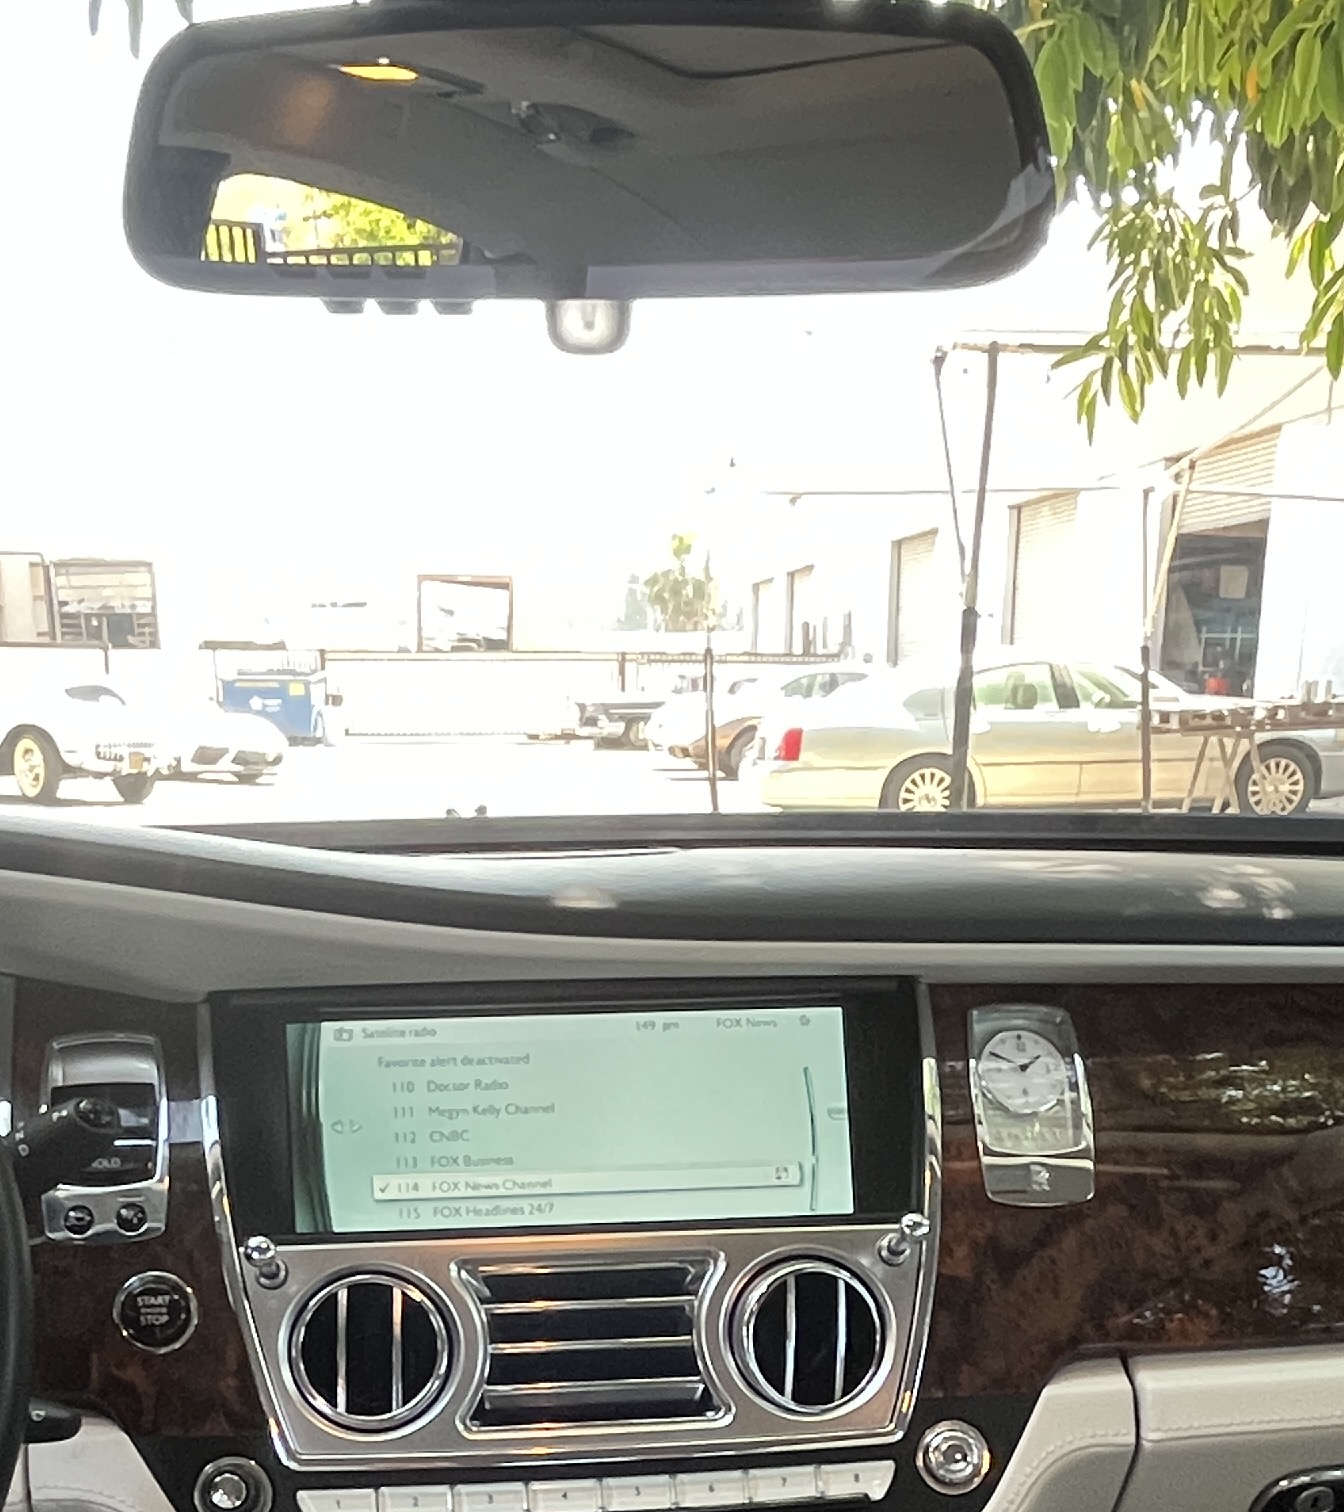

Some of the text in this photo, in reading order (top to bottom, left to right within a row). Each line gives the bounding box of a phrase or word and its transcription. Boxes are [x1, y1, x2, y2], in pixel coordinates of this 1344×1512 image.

[716, 1017, 778, 1029] FOX News
[429, 1054, 457, 1068] alert
[460, 1053, 531, 1067] deactivated
[391, 1078, 509, 1094] 110 Doctor Radio
[393, 1106, 414, 1119] 111
[472, 1103, 502, 1118] Kelly
[504, 1102, 556, 1116] Channel
[394, 1129, 471, 1144] 112 CNBC
[430, 1155, 460, 1168] FOX
[397, 1178, 553, 1193] 114 FOX News Channel
[398, 1202, 555, 1220] 115 FOX Headlines 24/7
[137, 1294, 171, 1307] START
[140, 1314, 170, 1327] STOP
